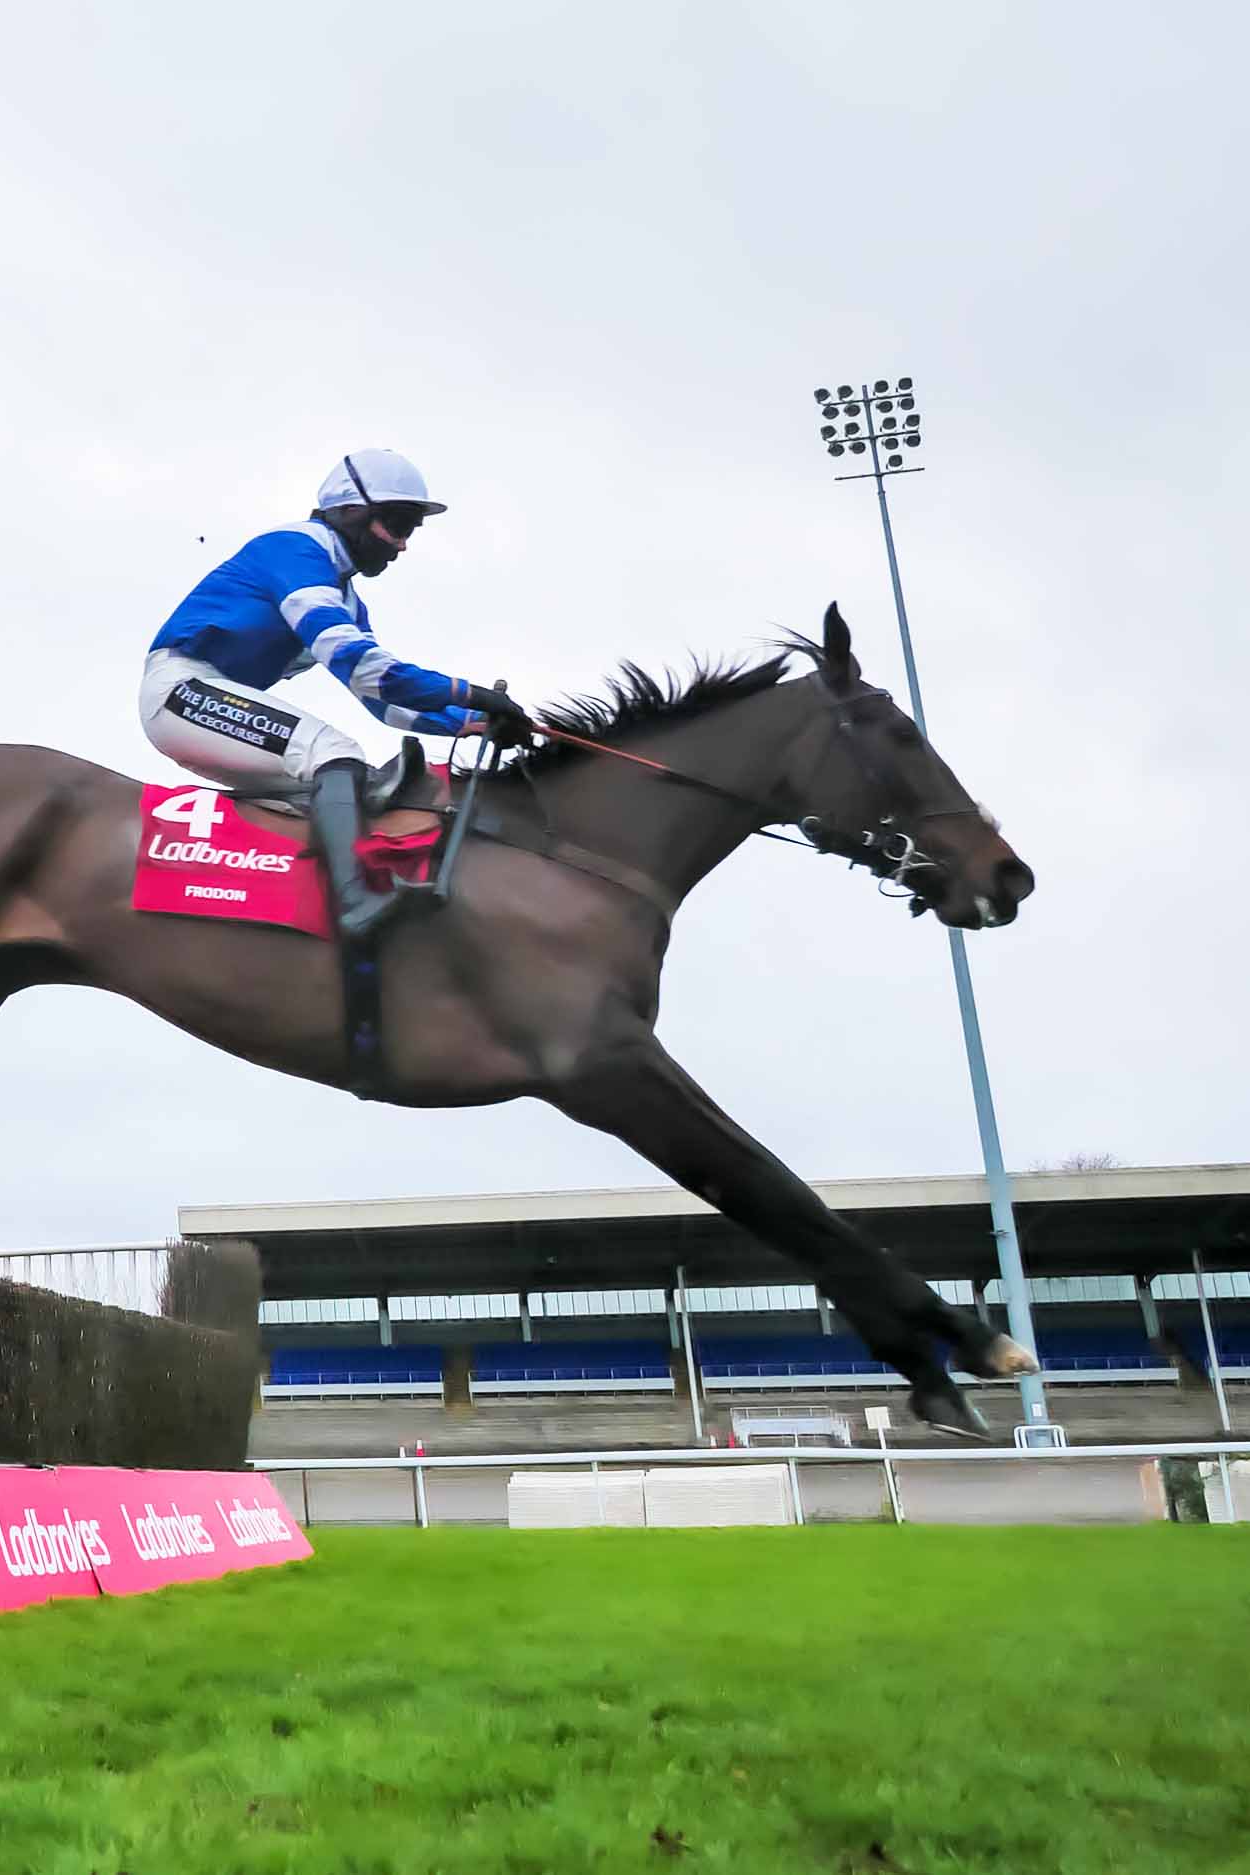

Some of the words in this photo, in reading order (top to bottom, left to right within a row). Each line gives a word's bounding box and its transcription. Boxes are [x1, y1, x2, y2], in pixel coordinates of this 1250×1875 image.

[174, 683, 202, 706] THE
[199, 696, 254, 725] JOCKEY
[252, 715, 292, 739] CLUB
[182, 707, 266, 746] RACECOURSES
[152, 788, 225, 838] 4
[148, 834, 295, 873] Ladbrokes
[185, 885, 247, 902] FRODON
[120, 1502, 215, 1561] Ladbrokes
[215, 1497, 293, 1548] Ladbrokes
